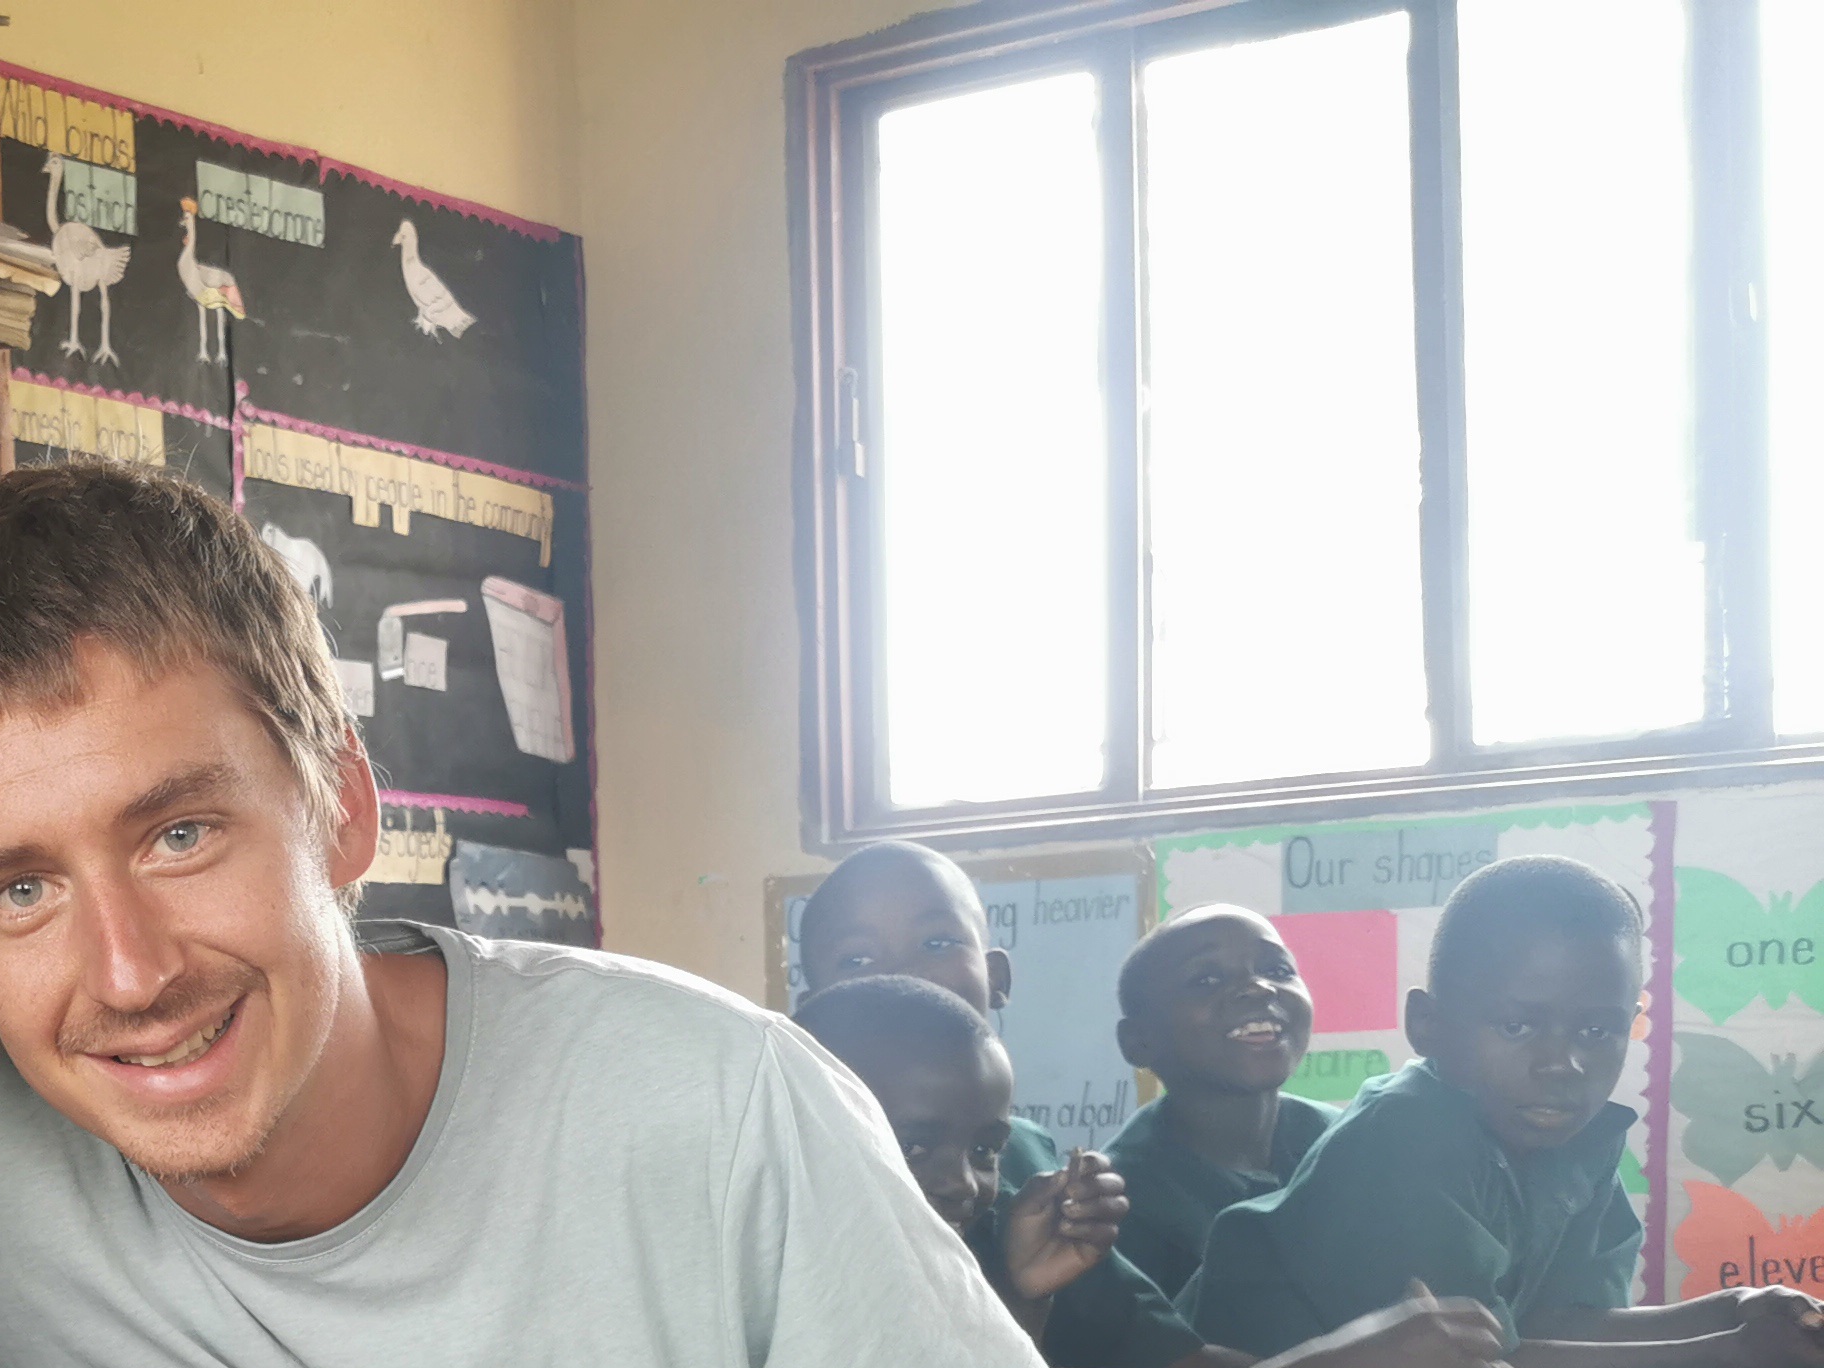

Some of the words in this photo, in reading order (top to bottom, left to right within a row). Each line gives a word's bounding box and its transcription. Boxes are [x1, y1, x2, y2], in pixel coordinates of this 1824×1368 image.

[1285, 836, 1353, 888] Our
[1372, 829, 1491, 905] shapes
[1033, 880, 1130, 925] heavier
[1726, 937, 1816, 968] one
[1057, 1104, 1074, 1128] a
[1079, 1080, 1129, 1128] ball
[1743, 1090, 1824, 1133] six
